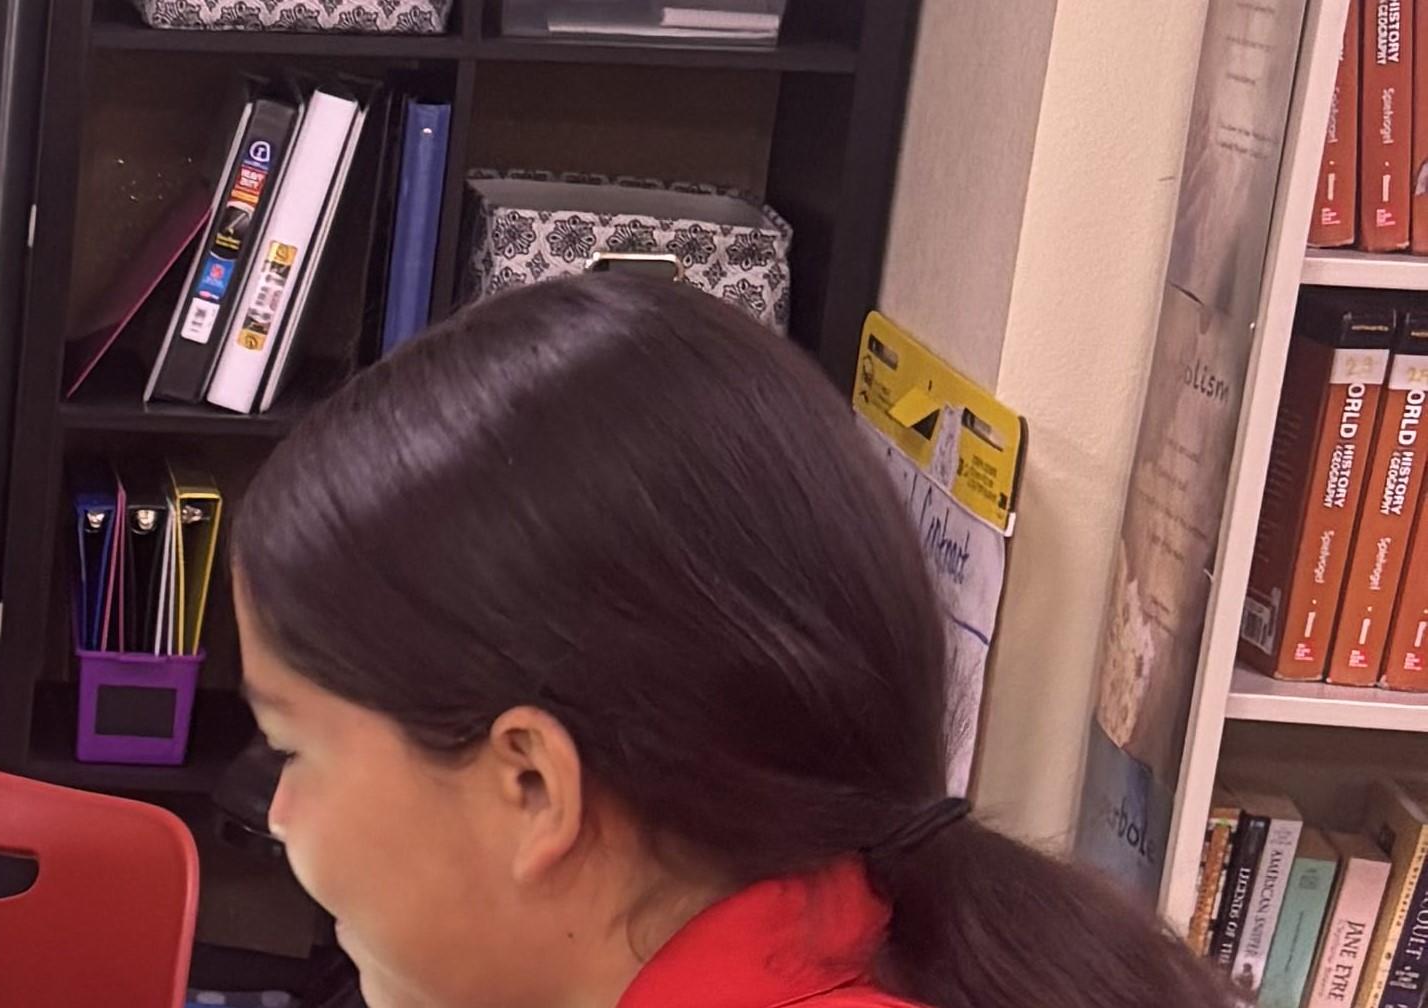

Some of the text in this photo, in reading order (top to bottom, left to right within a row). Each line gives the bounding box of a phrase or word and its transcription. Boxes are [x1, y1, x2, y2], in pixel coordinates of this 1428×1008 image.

[1333, 382, 1366, 509] ORLD HISTORY
[1390, 389, 1426, 516] ORLD HISTORY
[1258, 850, 1283, 914] AMERICAN
[1244, 914, 1265, 958] SNIPER
[1338, 920, 1366, 961] JANE
[1328, 964, 1354, 1002] EYRE
